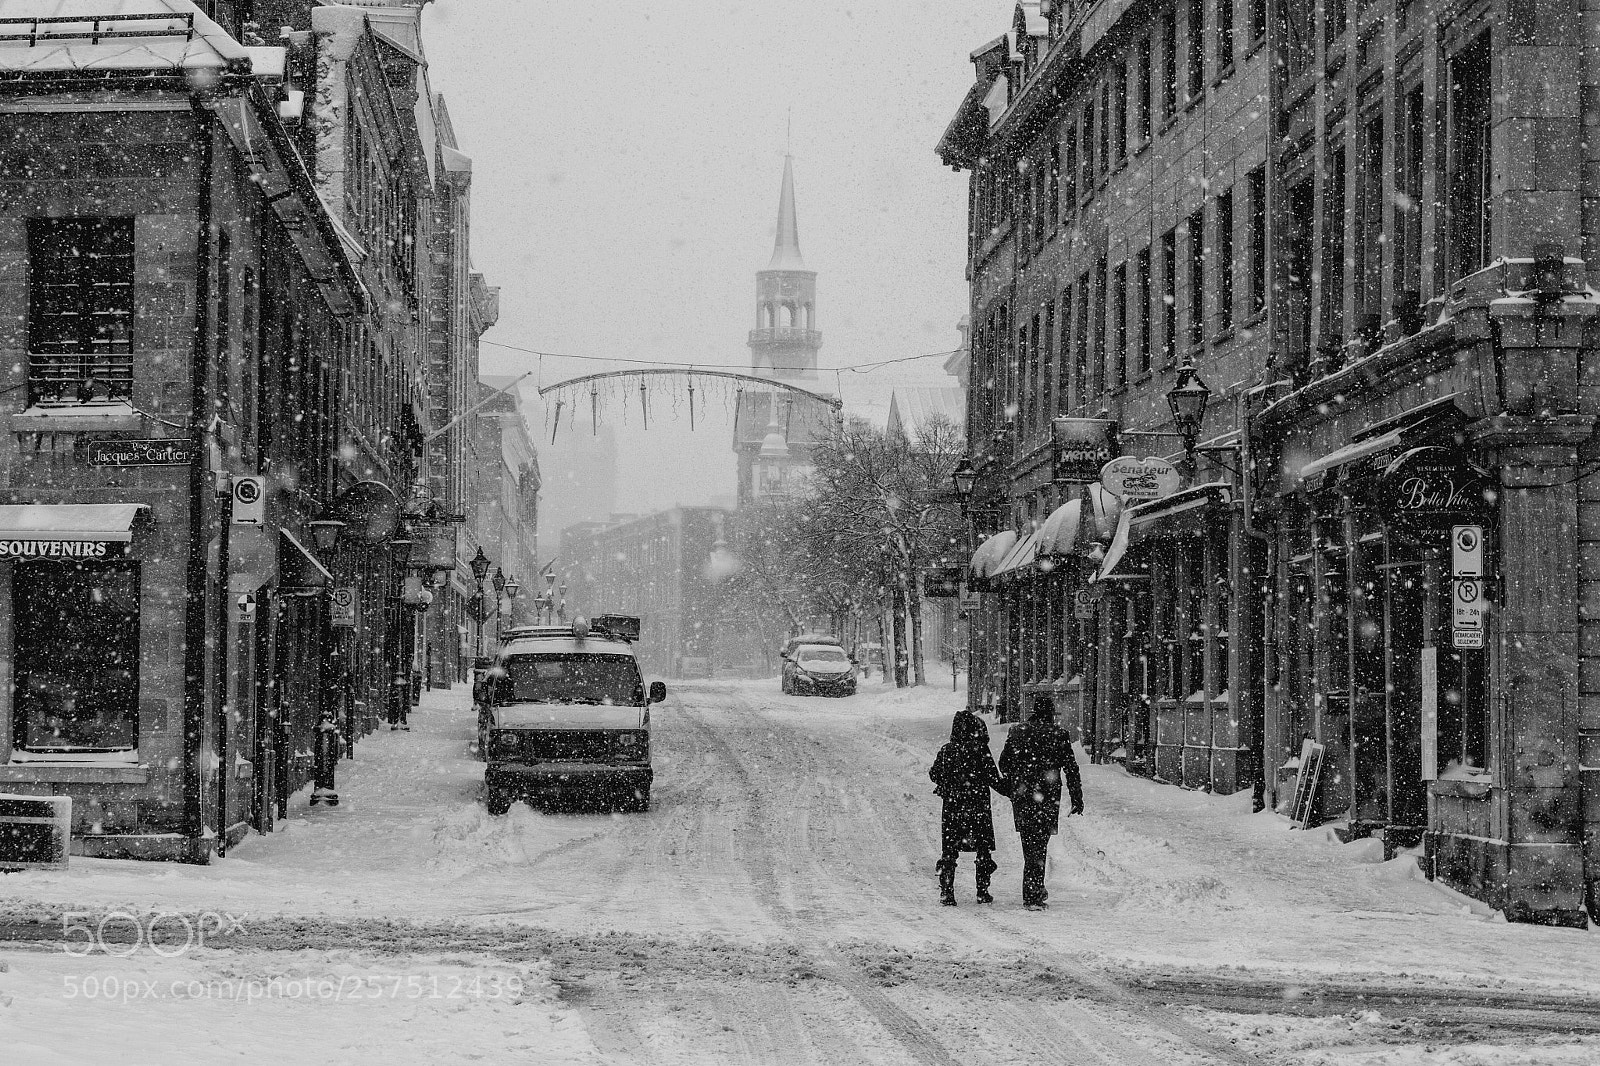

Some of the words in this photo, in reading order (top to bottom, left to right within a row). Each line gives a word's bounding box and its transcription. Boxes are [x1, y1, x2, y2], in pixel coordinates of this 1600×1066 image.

[94, 448, 189, 464] Jacques-Cartier
[1396, 477, 1444, 509] Bella
[1444, 479, 1477, 508] Vita
[0, 541, 106, 556] SOUVENIRS
